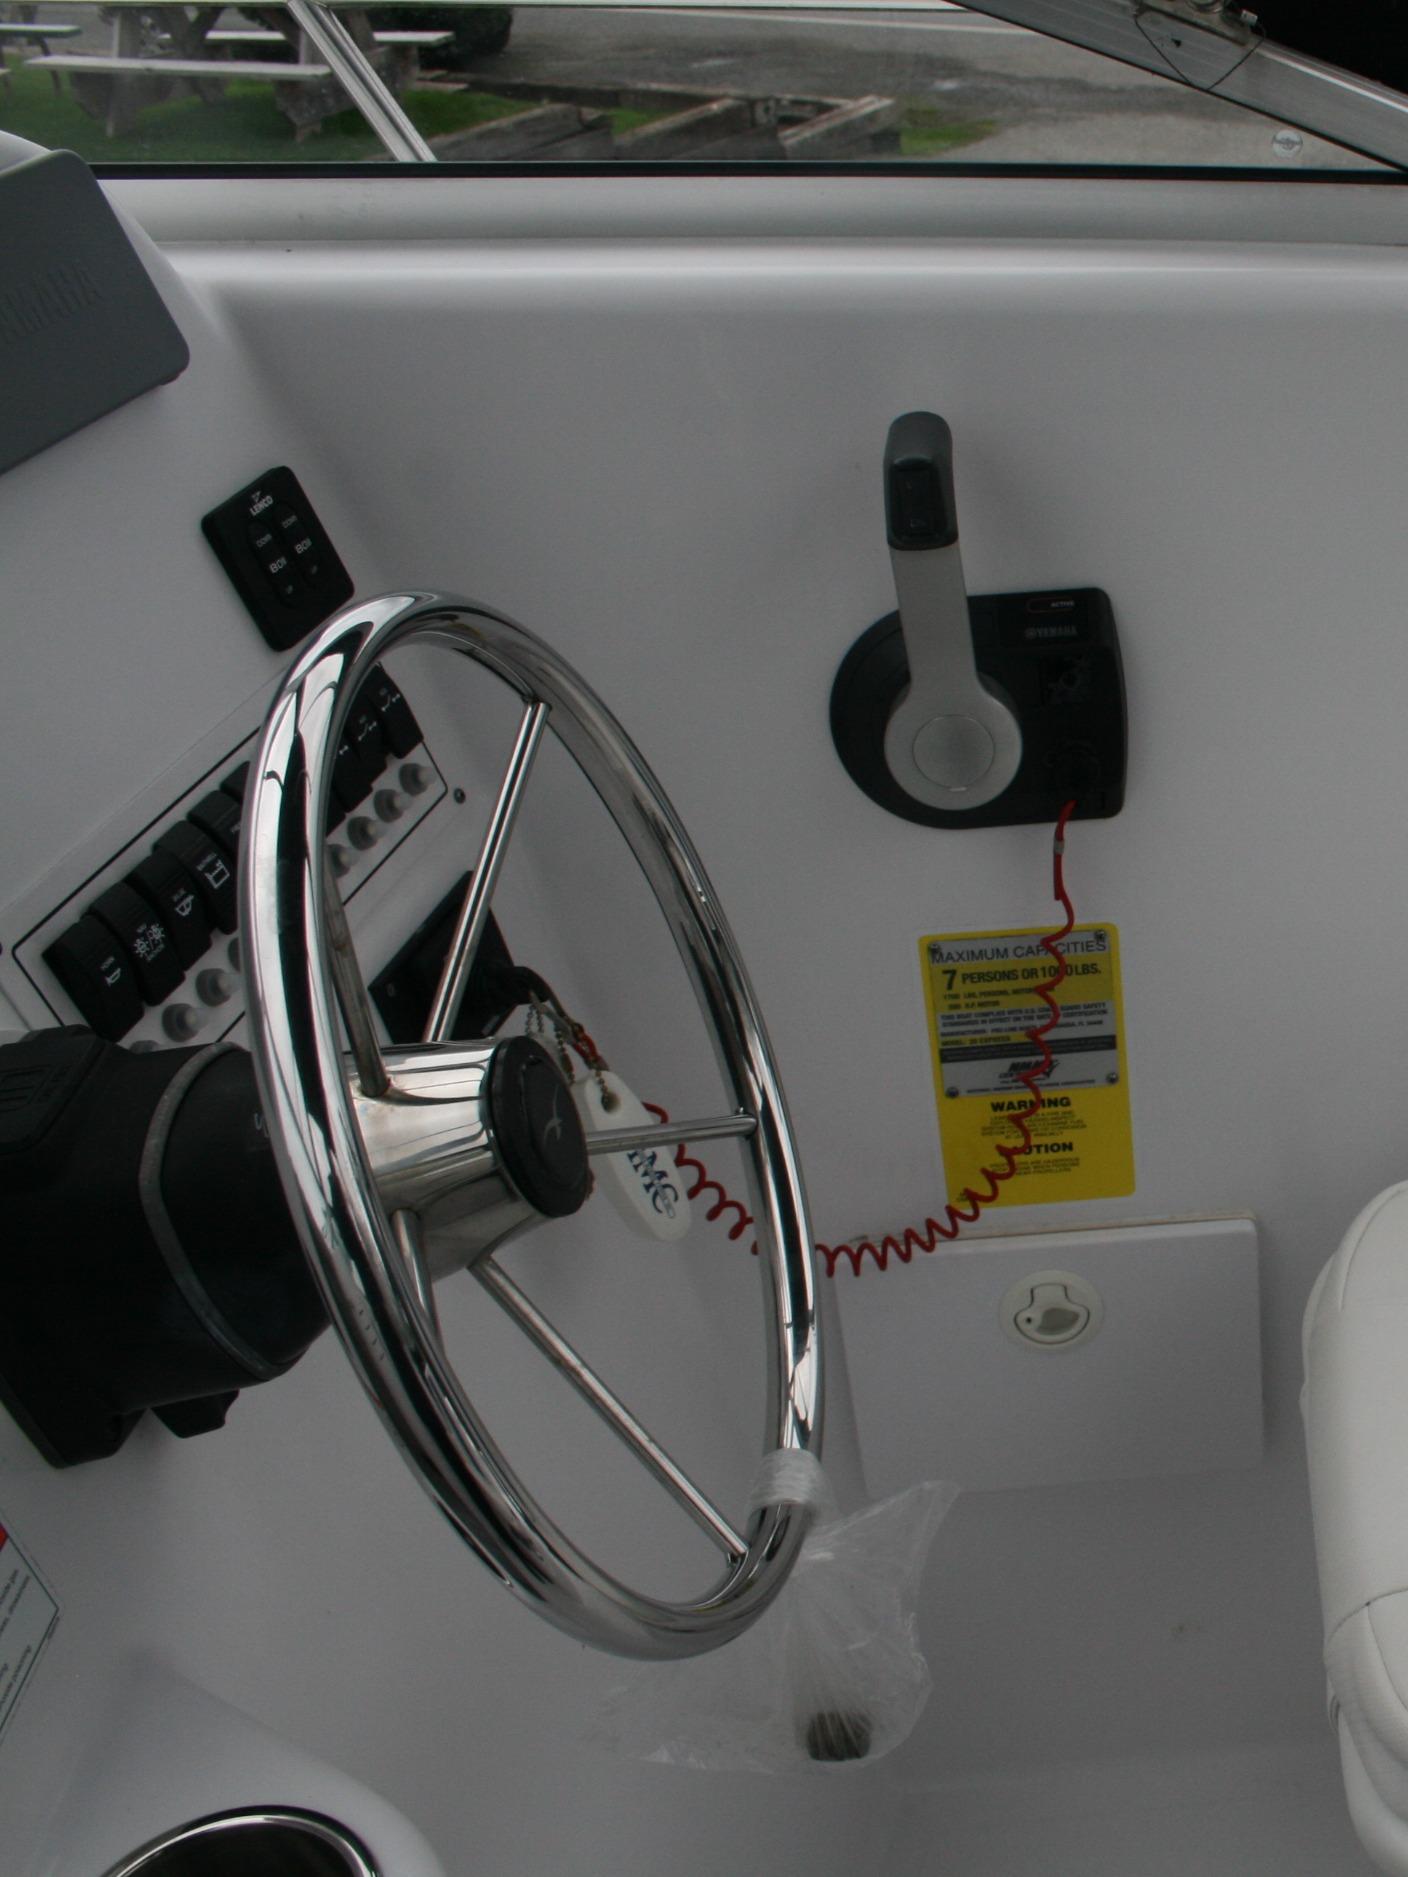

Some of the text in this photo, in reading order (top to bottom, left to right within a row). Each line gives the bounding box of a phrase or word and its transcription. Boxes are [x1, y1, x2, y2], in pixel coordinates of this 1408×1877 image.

[931, 945, 1009, 964] MAXIMUM
[941, 969, 957, 990] 7
[961, 968, 1019, 984] PERSONS
[1022, 967, 1039, 980] OR
[1074, 962, 1102, 976] LBS.
[998, 1142, 1073, 1155] UTION
